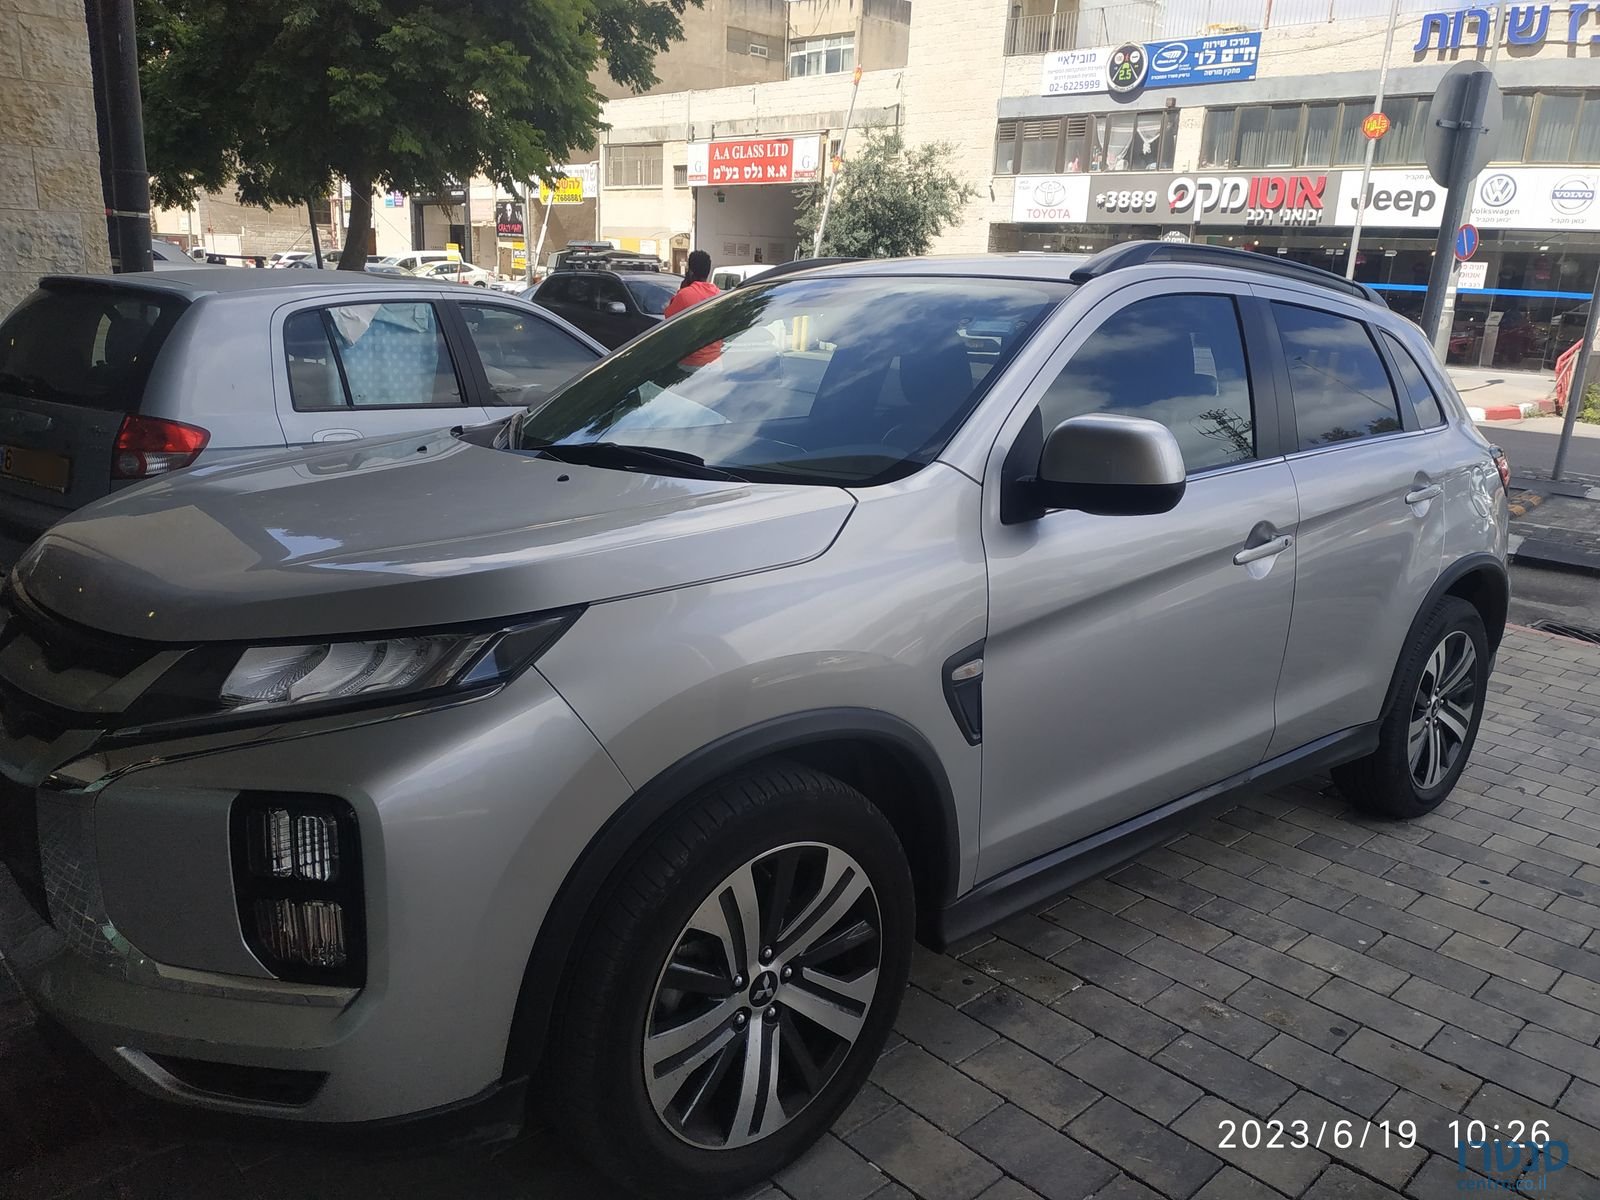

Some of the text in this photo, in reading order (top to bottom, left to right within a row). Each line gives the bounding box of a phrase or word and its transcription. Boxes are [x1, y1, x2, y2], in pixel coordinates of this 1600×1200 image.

[1414, 5, 1550, 50] שרות
[1203, 37, 1250, 49] מרכז שירות
[1194, 46, 1257, 65] חיים לוי
[1049, 80, 1101, 92] 02-6225999
[713, 143, 788, 160] A.A GLASS LTD
[744, 162, 763, 179] גלס
[767, 164, 787, 178] א.א
[1351, 182, 1436, 217] Jeep
[1554, 190, 1594, 199] VOLVO
[1027, 208, 1070, 219] TOYOTA
[1246, 208, 1322, 222] יבואני רכב
[1471, 208, 1520, 216] Volkswagen
